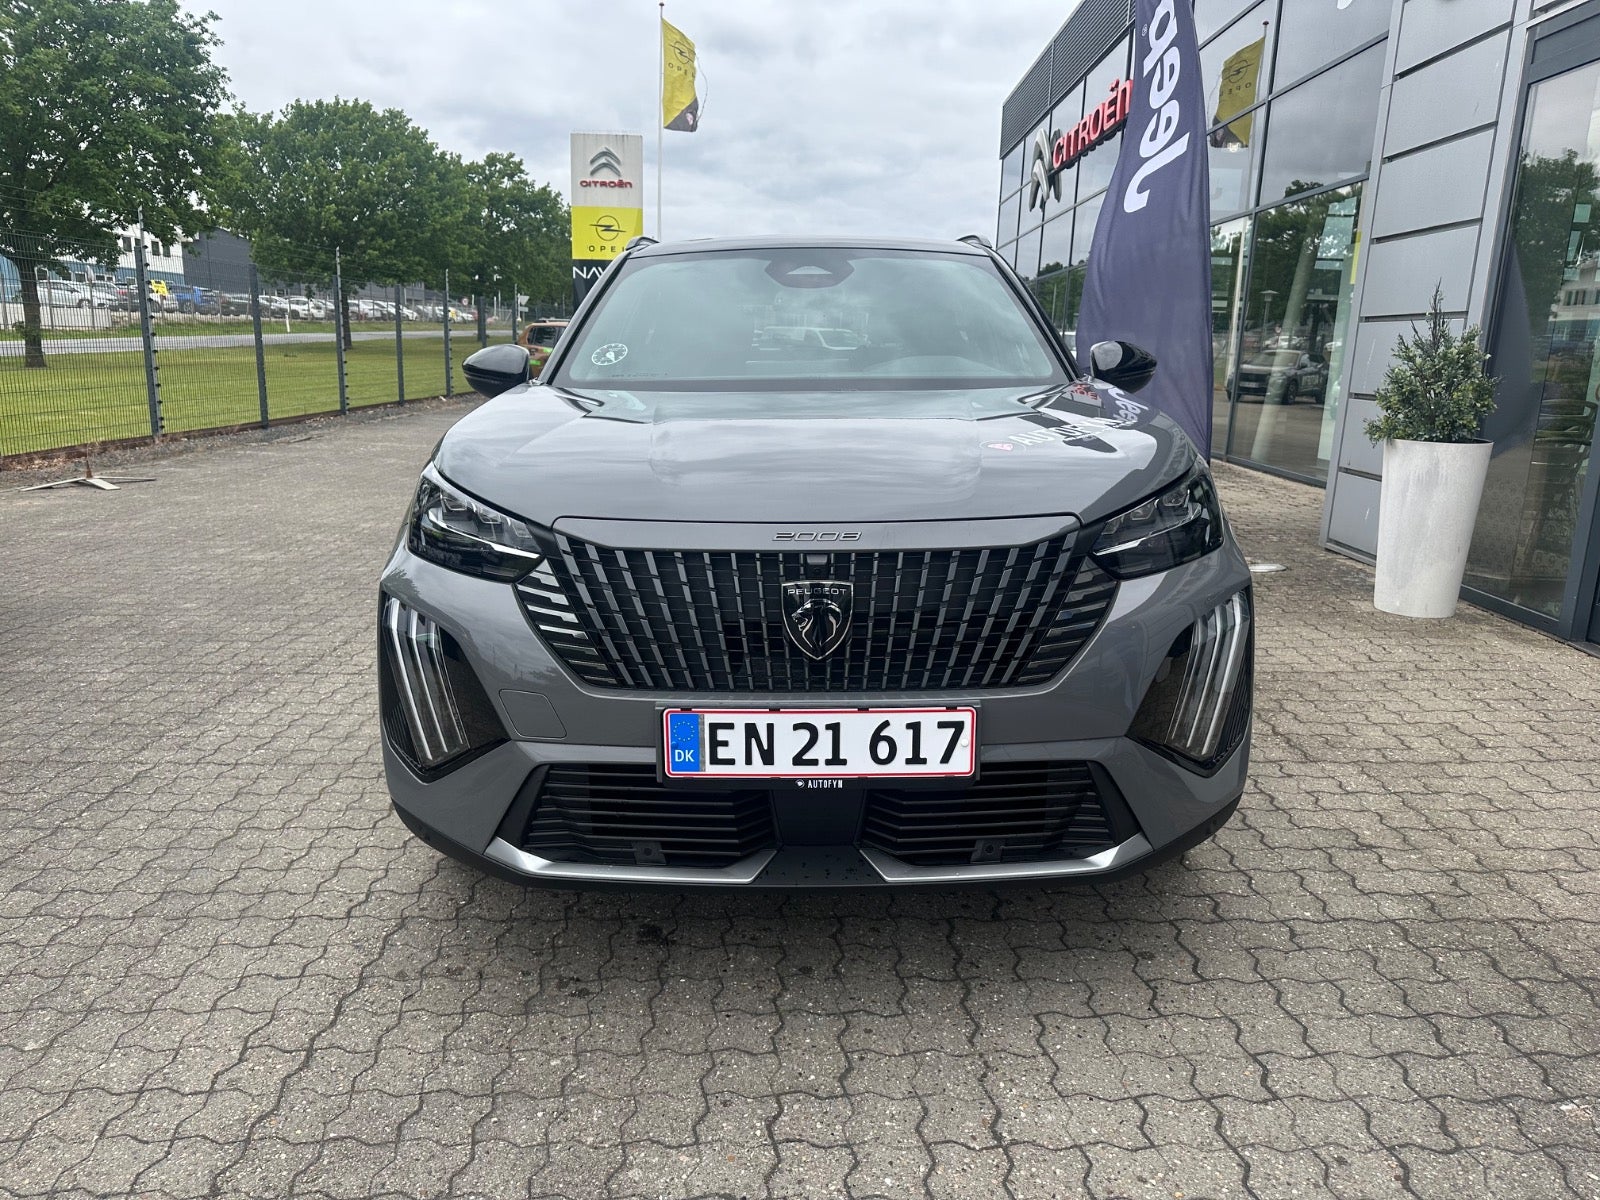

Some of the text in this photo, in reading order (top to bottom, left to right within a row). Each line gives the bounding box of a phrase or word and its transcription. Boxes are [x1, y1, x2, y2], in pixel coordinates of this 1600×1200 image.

[1124, 0, 1190, 213] Jeep
[772, 531, 862, 541] 2008
[787, 587, 847, 596] PEUGEOT
[708, 719, 965, 766] EN 21 617
[674, 749, 695, 763] DK
[807, 779, 843, 789] AUTOFYN
